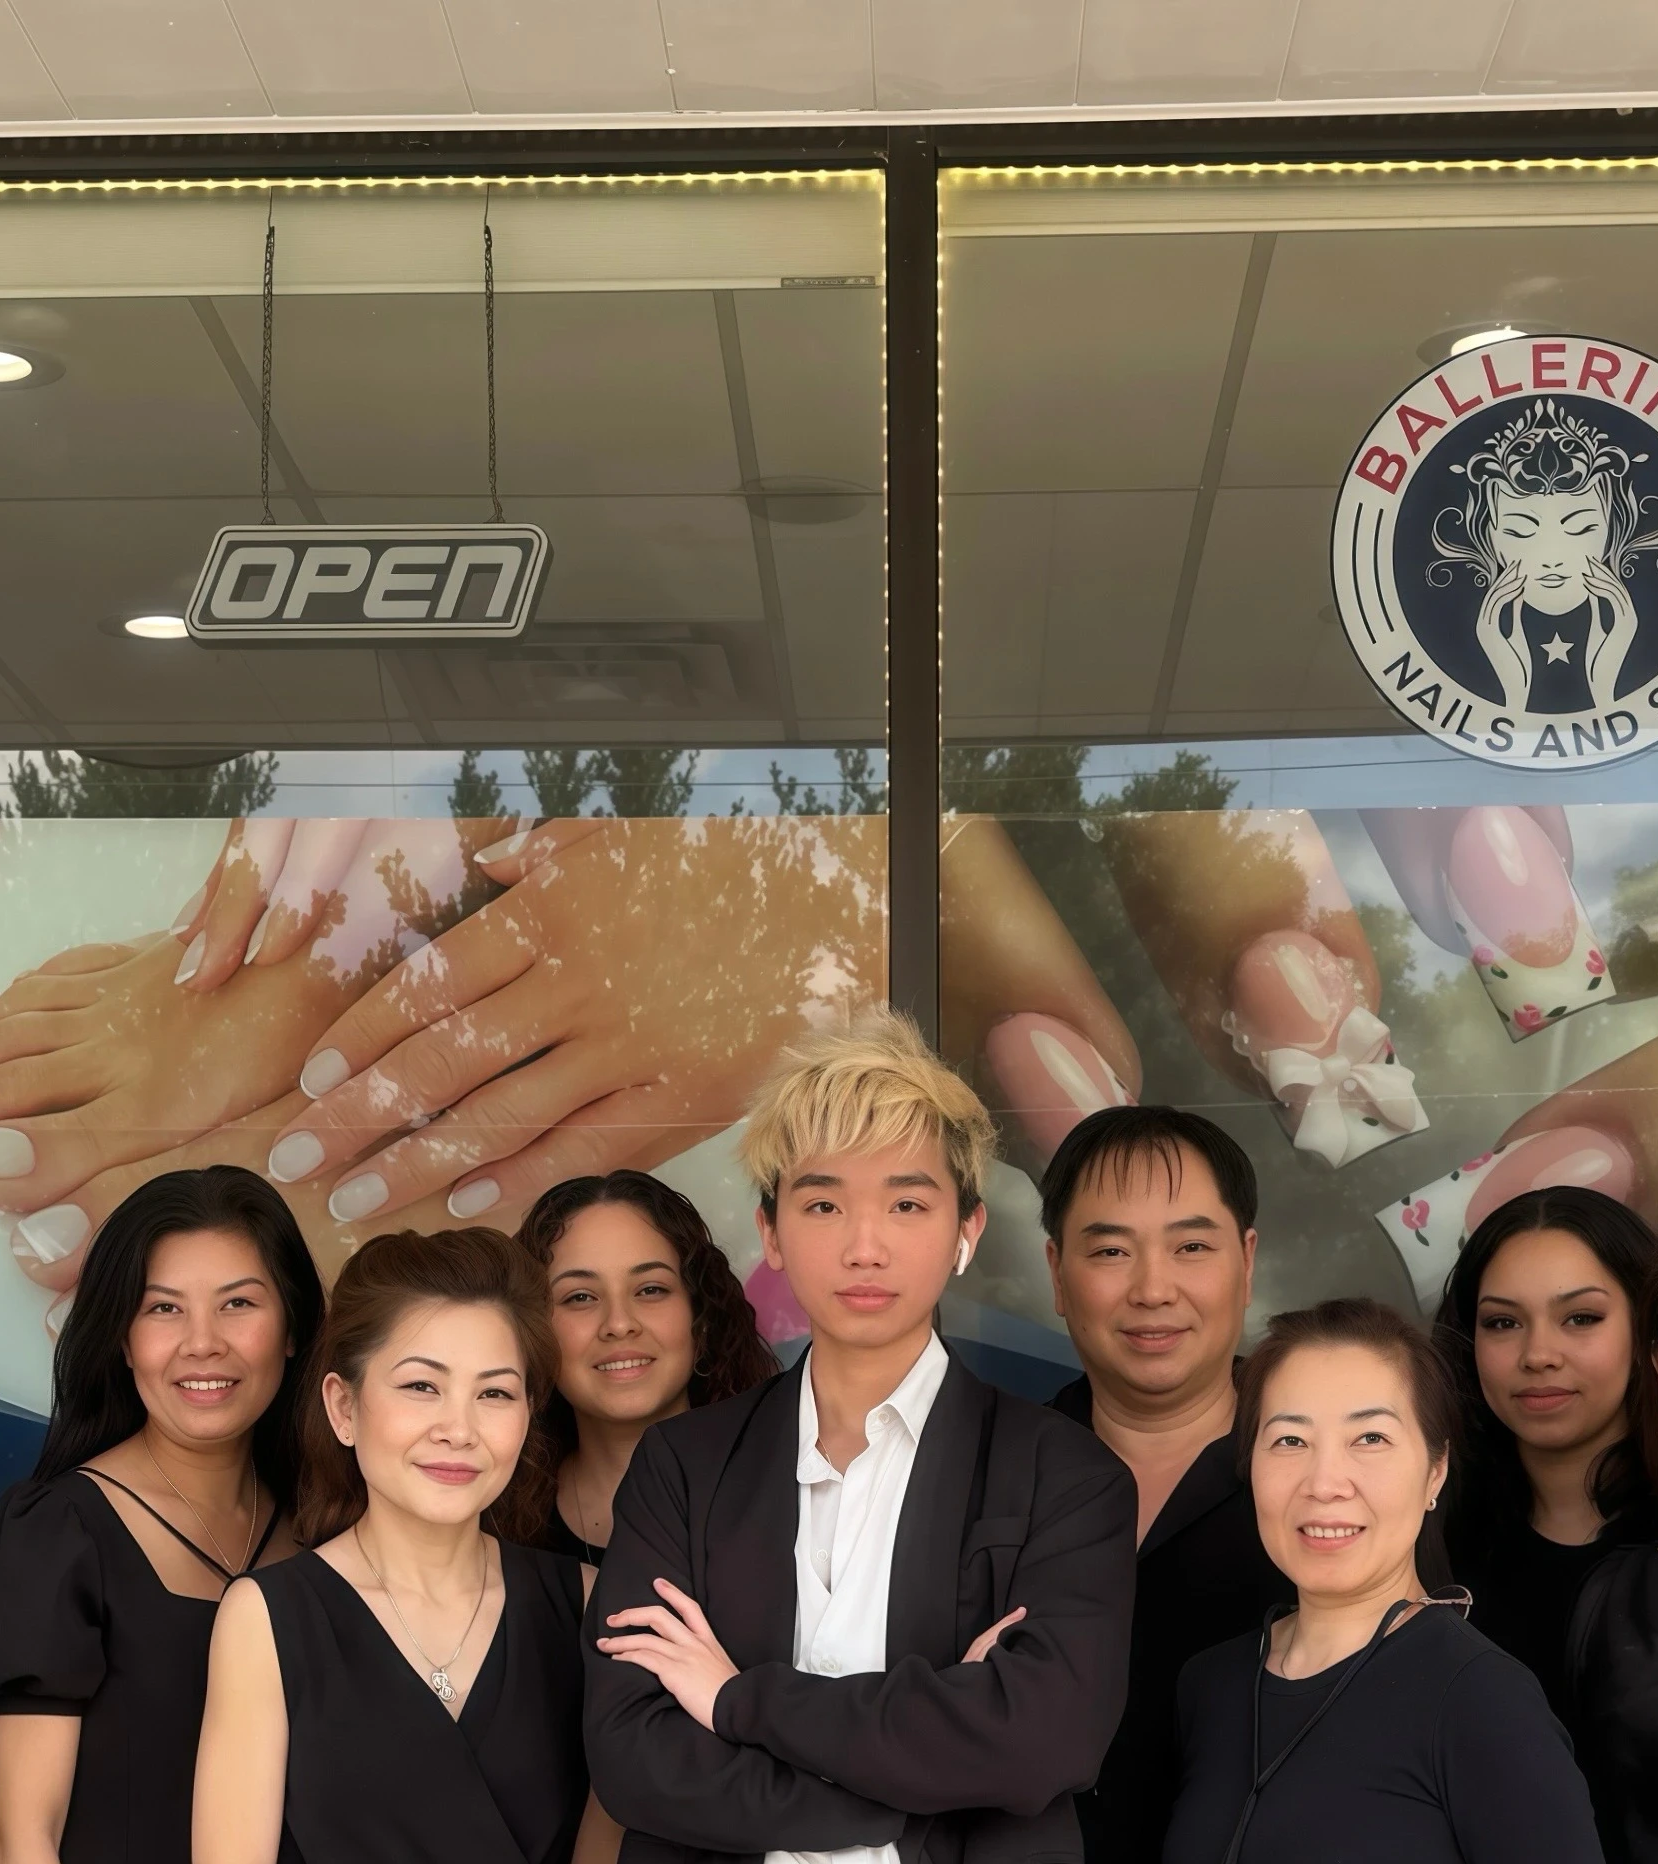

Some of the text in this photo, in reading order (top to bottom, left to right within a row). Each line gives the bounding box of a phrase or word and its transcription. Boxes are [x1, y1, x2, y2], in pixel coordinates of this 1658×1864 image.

[210, 545, 523, 619] OPEN
[1383, 651, 1517, 756] NAILS
[1532, 709, 1639, 758] AND
